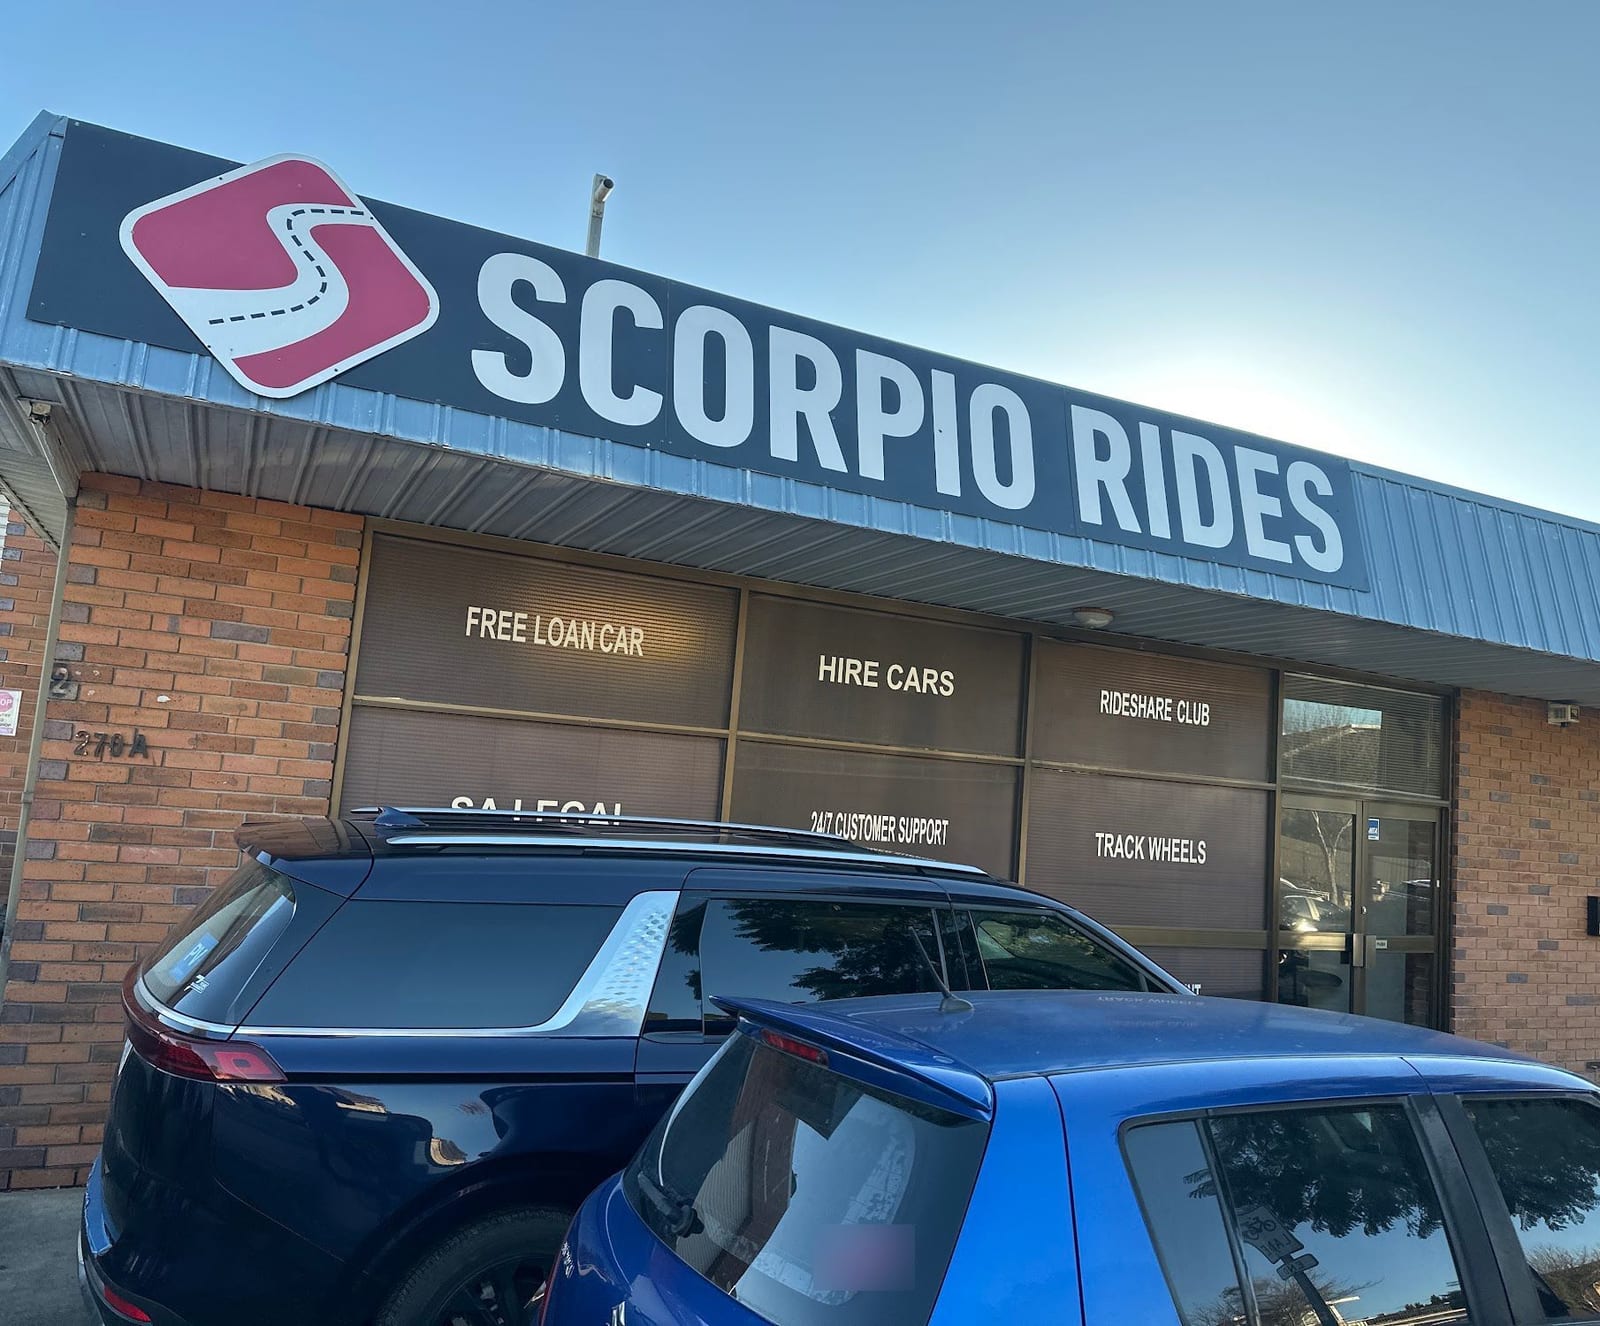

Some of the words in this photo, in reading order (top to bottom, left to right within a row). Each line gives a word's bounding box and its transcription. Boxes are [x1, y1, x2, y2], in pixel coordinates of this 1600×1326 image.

[471, 251, 1035, 511] SCORPIO
[1070, 403, 1344, 574] RIDES
[465, 606, 528, 643] FREE
[533, 615, 596, 650] LOAN
[599, 623, 644, 657] CAR
[818, 654, 880, 688] HIRE
[886, 663, 955, 697] CARS
[1100, 689, 1173, 721] RIDESHARE
[1177, 699, 1210, 726] CLUB
[810, 810, 833, 834] 24/7
[835, 812, 896, 842] CUSTOMER
[898, 816, 949, 846] SUPPORT
[1095, 832, 1145, 860] TRACK
[1148, 836, 1207, 865] WHEELS
